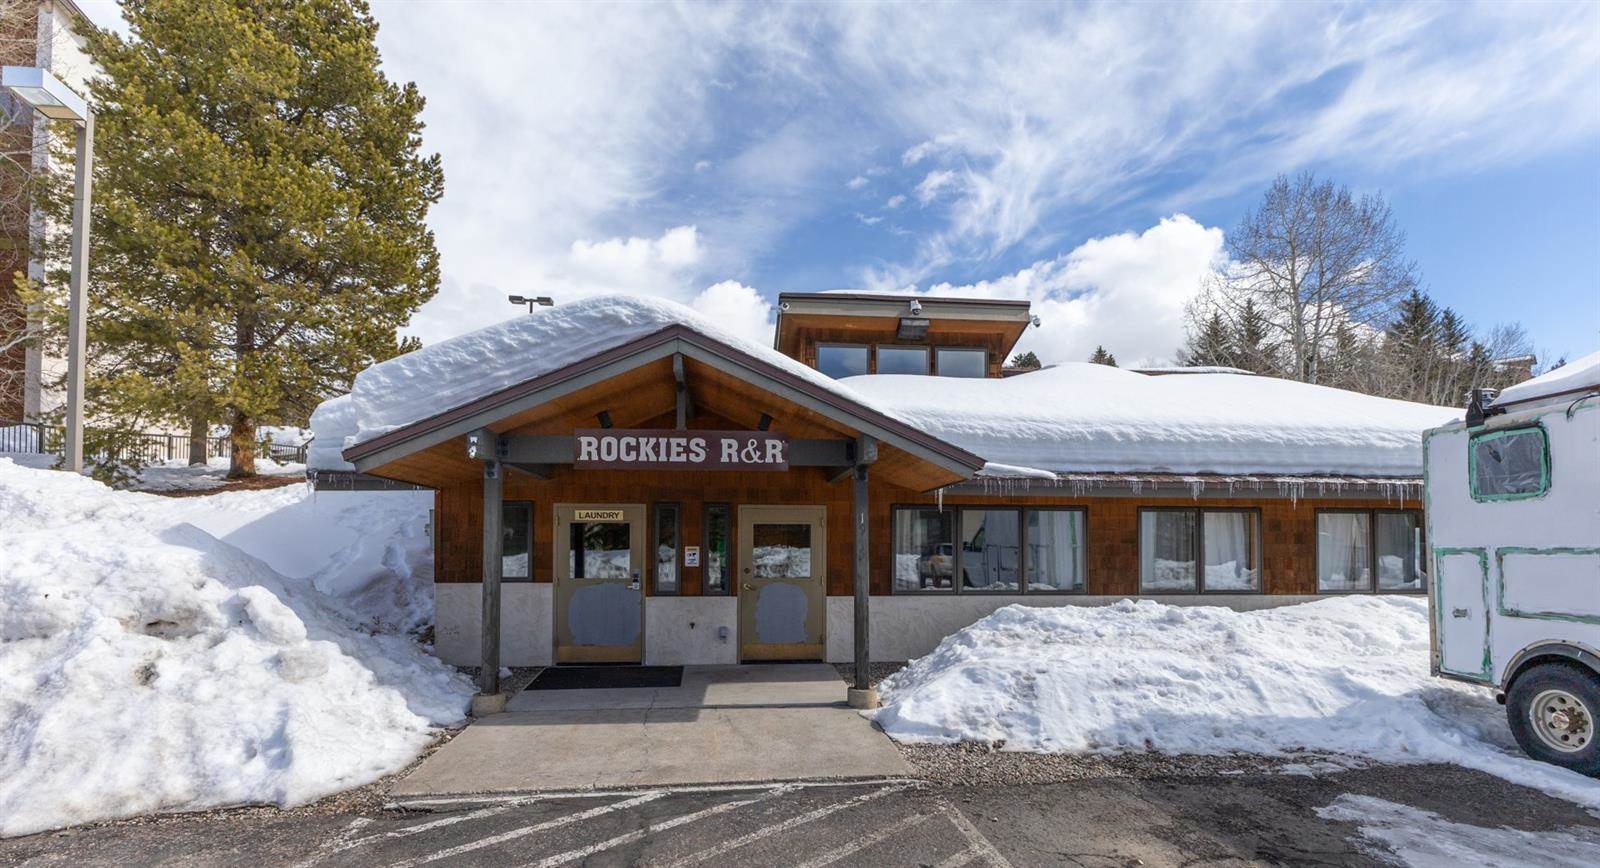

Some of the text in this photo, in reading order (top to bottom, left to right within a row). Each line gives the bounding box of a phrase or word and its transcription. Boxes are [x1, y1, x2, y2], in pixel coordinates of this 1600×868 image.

[579, 436, 783, 463] ROCKIES R&R
[578, 511, 620, 519] LAUNDRY
